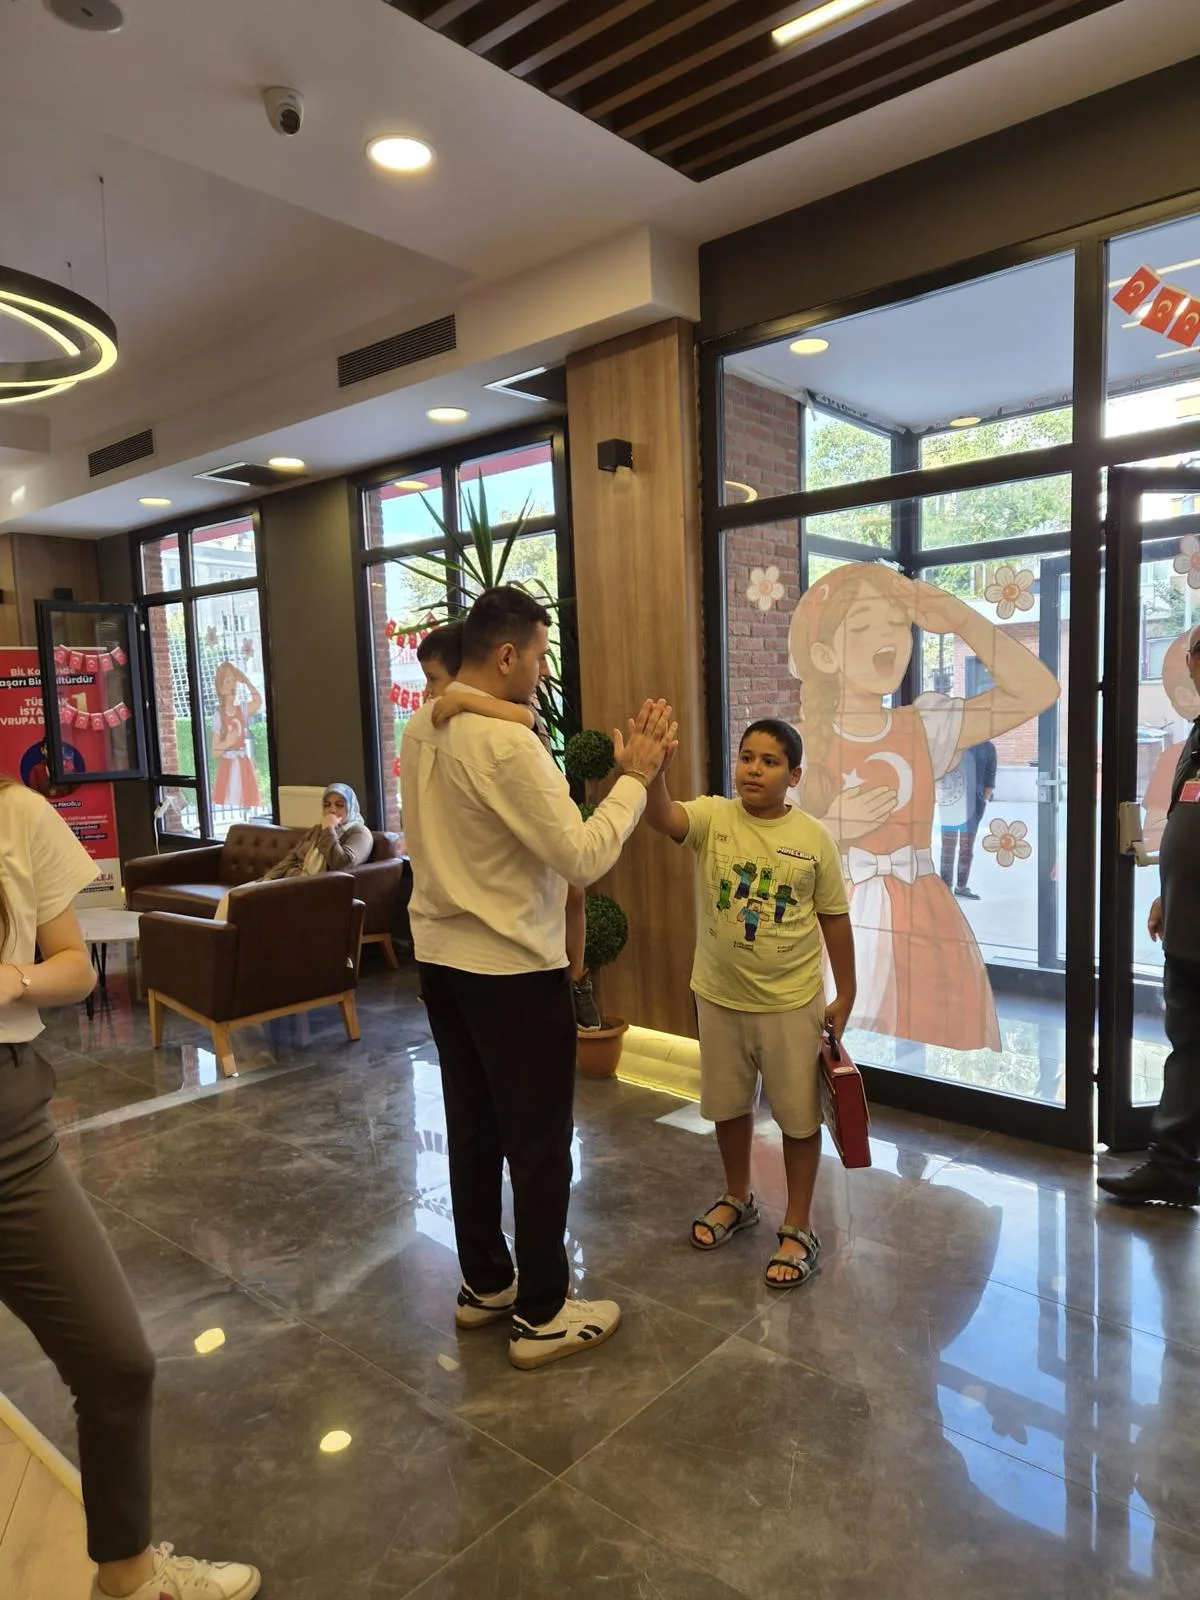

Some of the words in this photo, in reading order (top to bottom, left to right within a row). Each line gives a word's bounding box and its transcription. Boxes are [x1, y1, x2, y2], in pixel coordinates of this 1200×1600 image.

[10, 666, 26, 676] BİL
[0, 679, 27, 688] aşarı
[0, 717, 36, 725] VRUPA
